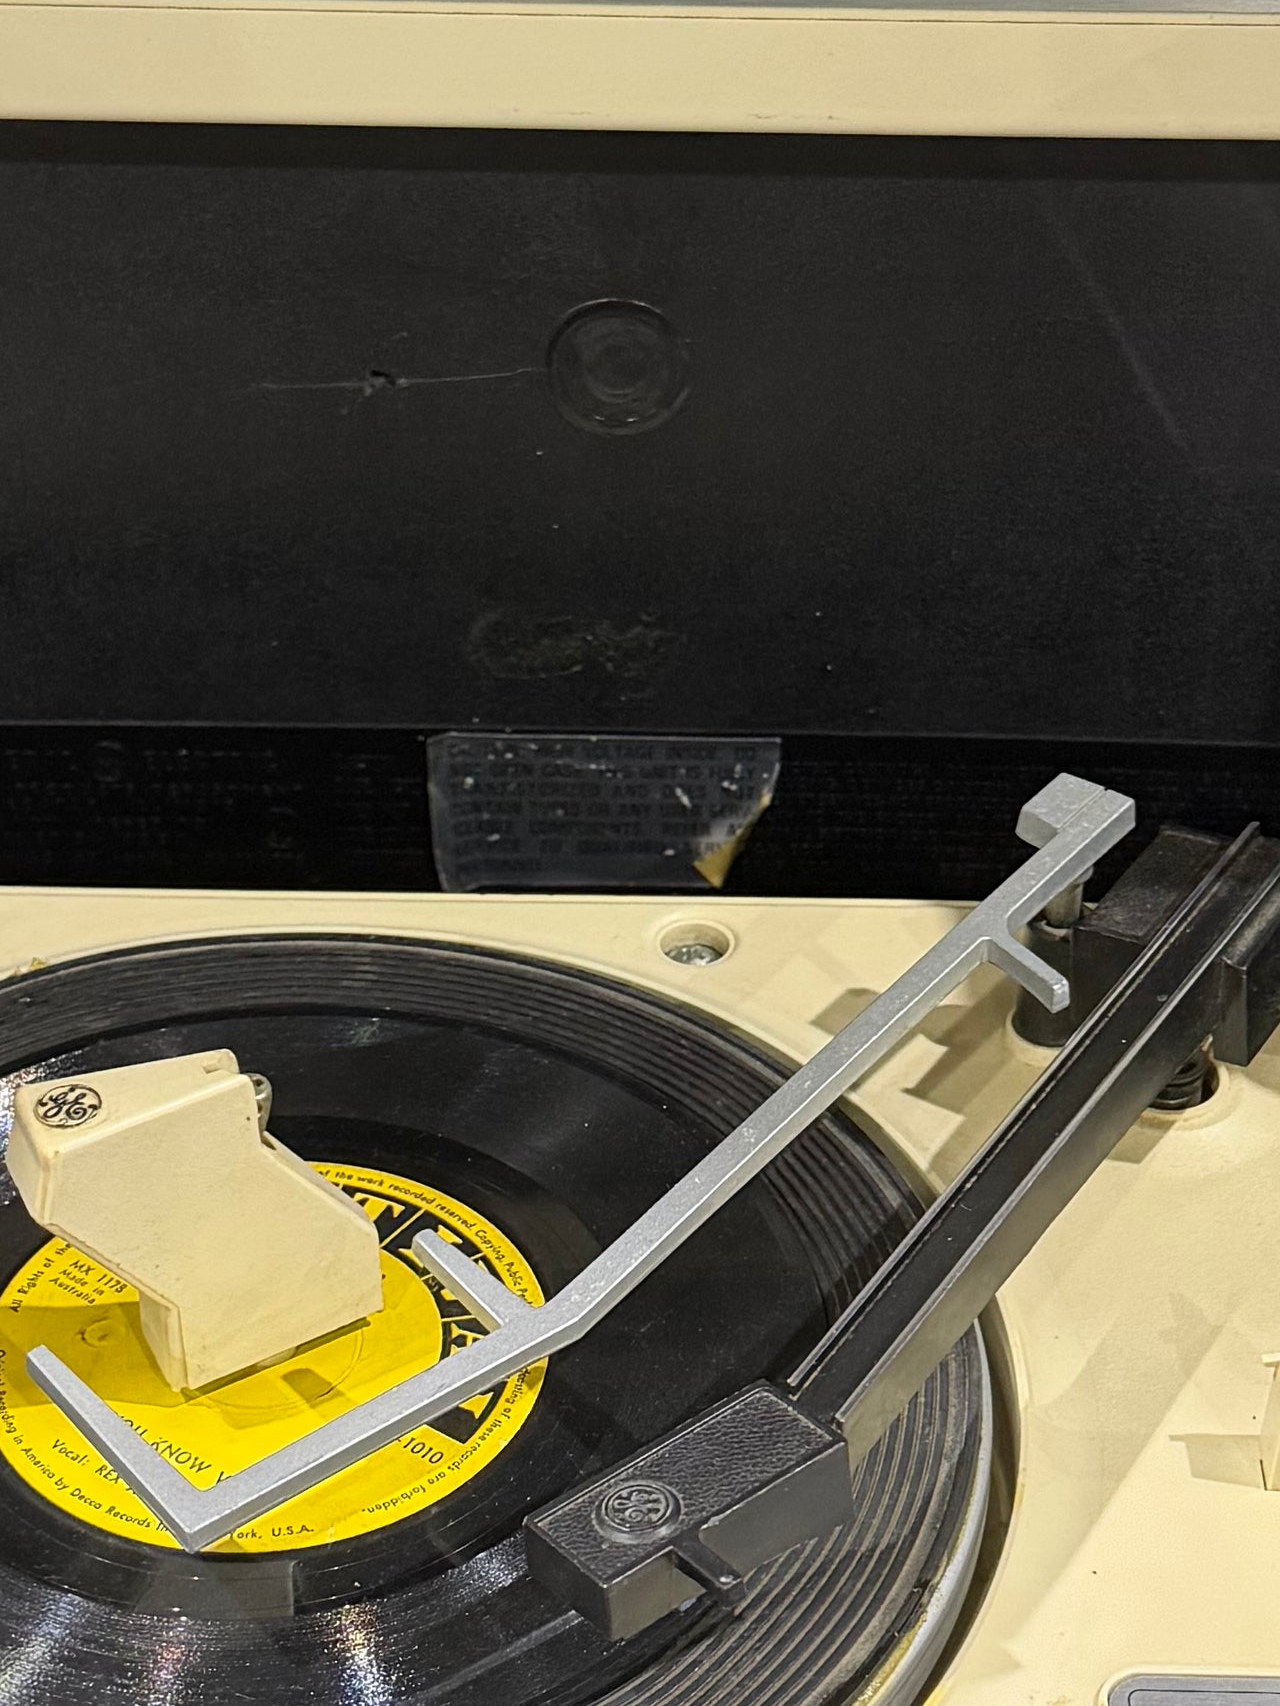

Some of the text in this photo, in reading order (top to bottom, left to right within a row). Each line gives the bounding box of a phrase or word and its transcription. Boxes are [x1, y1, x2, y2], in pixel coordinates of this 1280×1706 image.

[335, 1171, 354, 1181] the
[356, 1175, 385, 1188] work
[388, 1183, 436, 1207] recorded
[504, 1260, 523, 1288] Public
[70, 1259, 96, 1276] MX
[9, 1298, 22, 1313] All
[17, 1270, 44, 1294] Rights
[49, 1277, 96, 1305] Australia
[58, 1269, 105, 1297] Made in
[478, 1418, 503, 1442] these
[52, 1438, 121, 1485] Vocal: REX
[148, 1437, 212, 1473] KNOW
[448, 1442, 482, 1473] records
[13, 1434, 24, 1445] in
[20, 1447, 55, 1480] America
[54, 1477, 69, 1491] by
[70, 1488, 102, 1510] Decca
[105, 1505, 151, 1529] Records
[271, 1524, 314, 1538] U.S.A.
[428, 1471, 447, 1485] are
[362, 1485, 427, 1514] forbidden.
